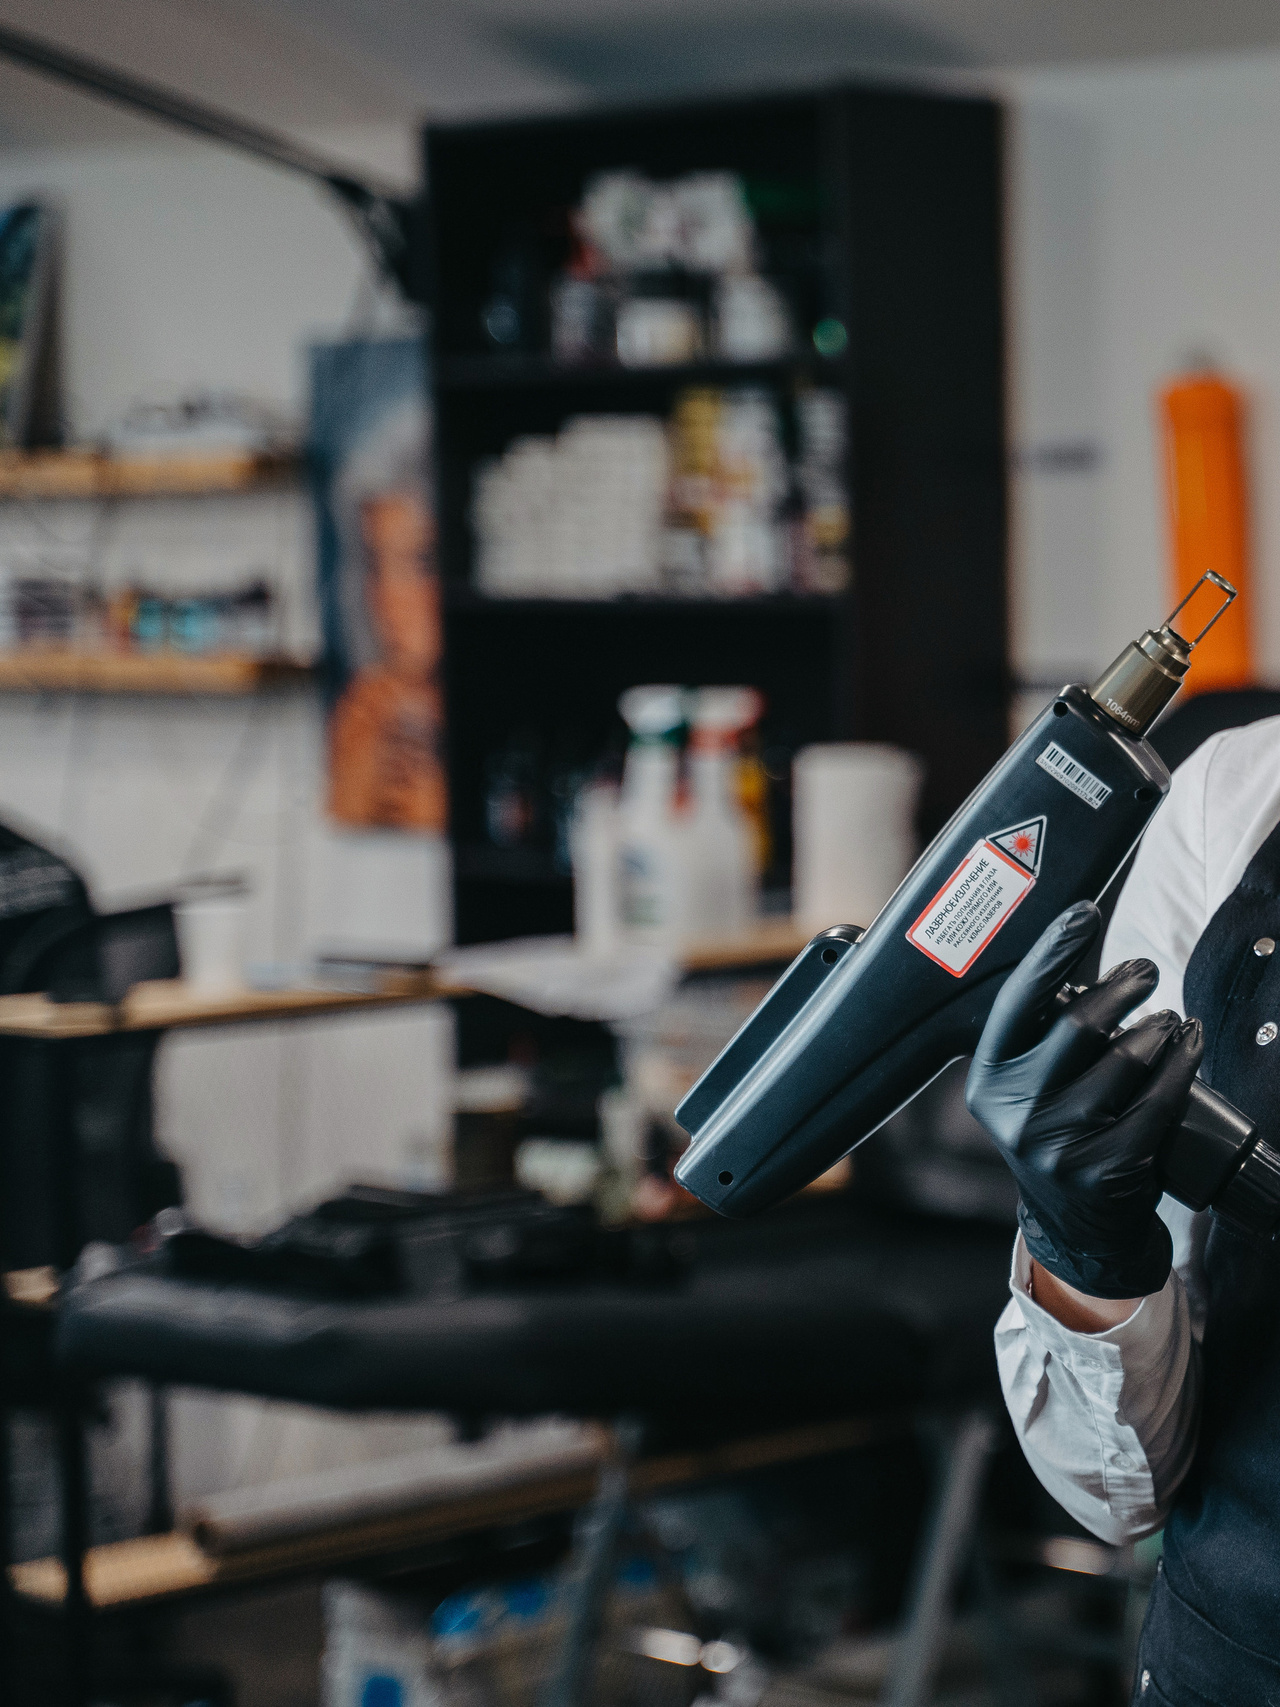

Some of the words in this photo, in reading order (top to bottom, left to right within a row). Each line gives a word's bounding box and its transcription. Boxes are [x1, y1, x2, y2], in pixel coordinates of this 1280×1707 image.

[1106, 698, 1140, 726] 1064nm
[925, 899, 957, 939] ЛАЗЕРНОЕ
[952, 858, 990, 903] ИЗЛУЧЕНИЕ
[934, 920, 957, 945] ИЗБЕГАТЬ
[953, 887, 981, 922] ПОПАДАНИЯ
[979, 881, 985, 889] В
[982, 867, 998, 886] ГЛАЗА
[945, 932, 958, 945] ИЛИ
[955, 916, 969, 933] КОЖУ
[966, 891, 989, 918] ПРЯМОГО
[986, 879, 999, 894] ИЛИ
[971, 922, 986, 941] КЛАСС
[982, 900, 1003, 925] ЛАЗЕРОВ
[978, 885, 1004, 917] ИЗЛУЧЕНИЯ
